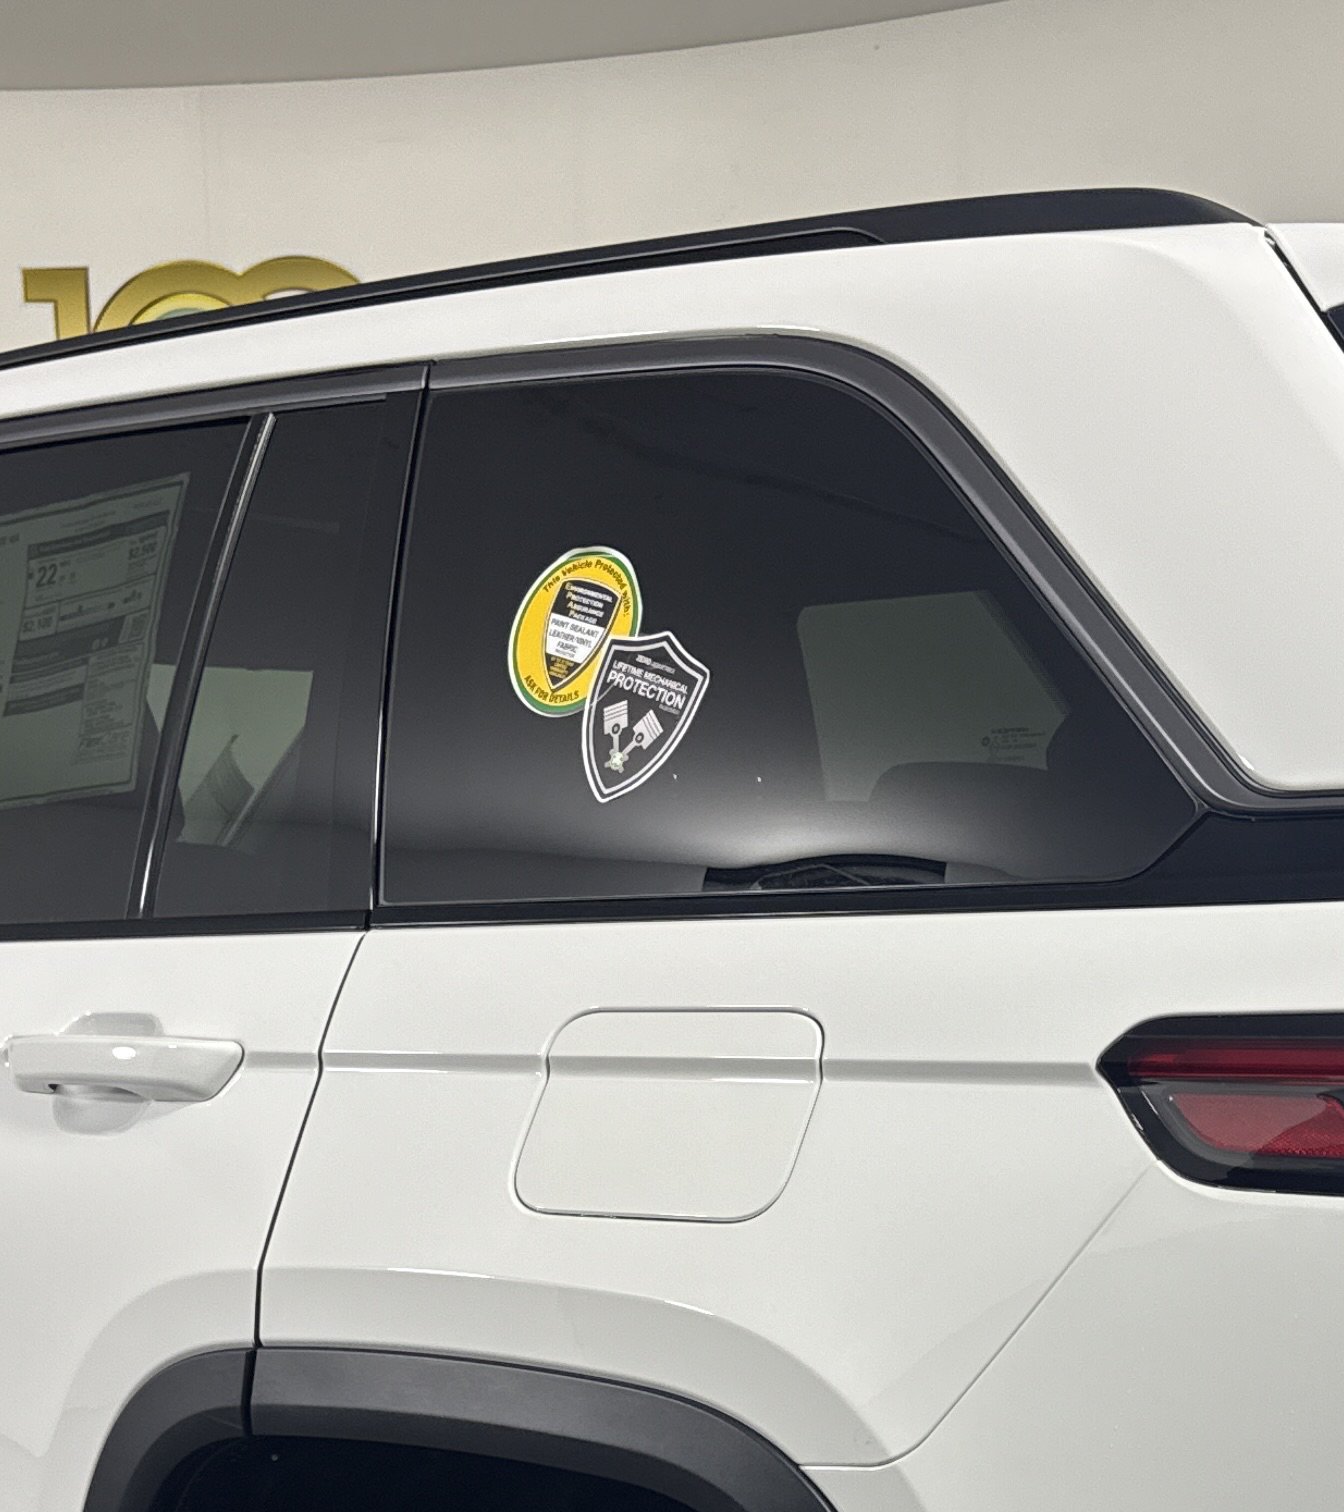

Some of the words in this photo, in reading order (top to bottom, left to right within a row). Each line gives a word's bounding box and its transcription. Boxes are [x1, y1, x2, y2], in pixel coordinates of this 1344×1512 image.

[36, 562, 58, 588] 22
[594, 559, 627, 591] Protected
[570, 623, 600, 638] SEALANT
[524, 675, 537, 692] ASK
[536, 688, 549, 702] FOR
[549, 690, 580, 704] DETAILS
[607, 669, 687, 710] PROTECTION
[612, 660, 644, 678] LIFETIME
[643, 671, 688, 694] MECHANICAL
